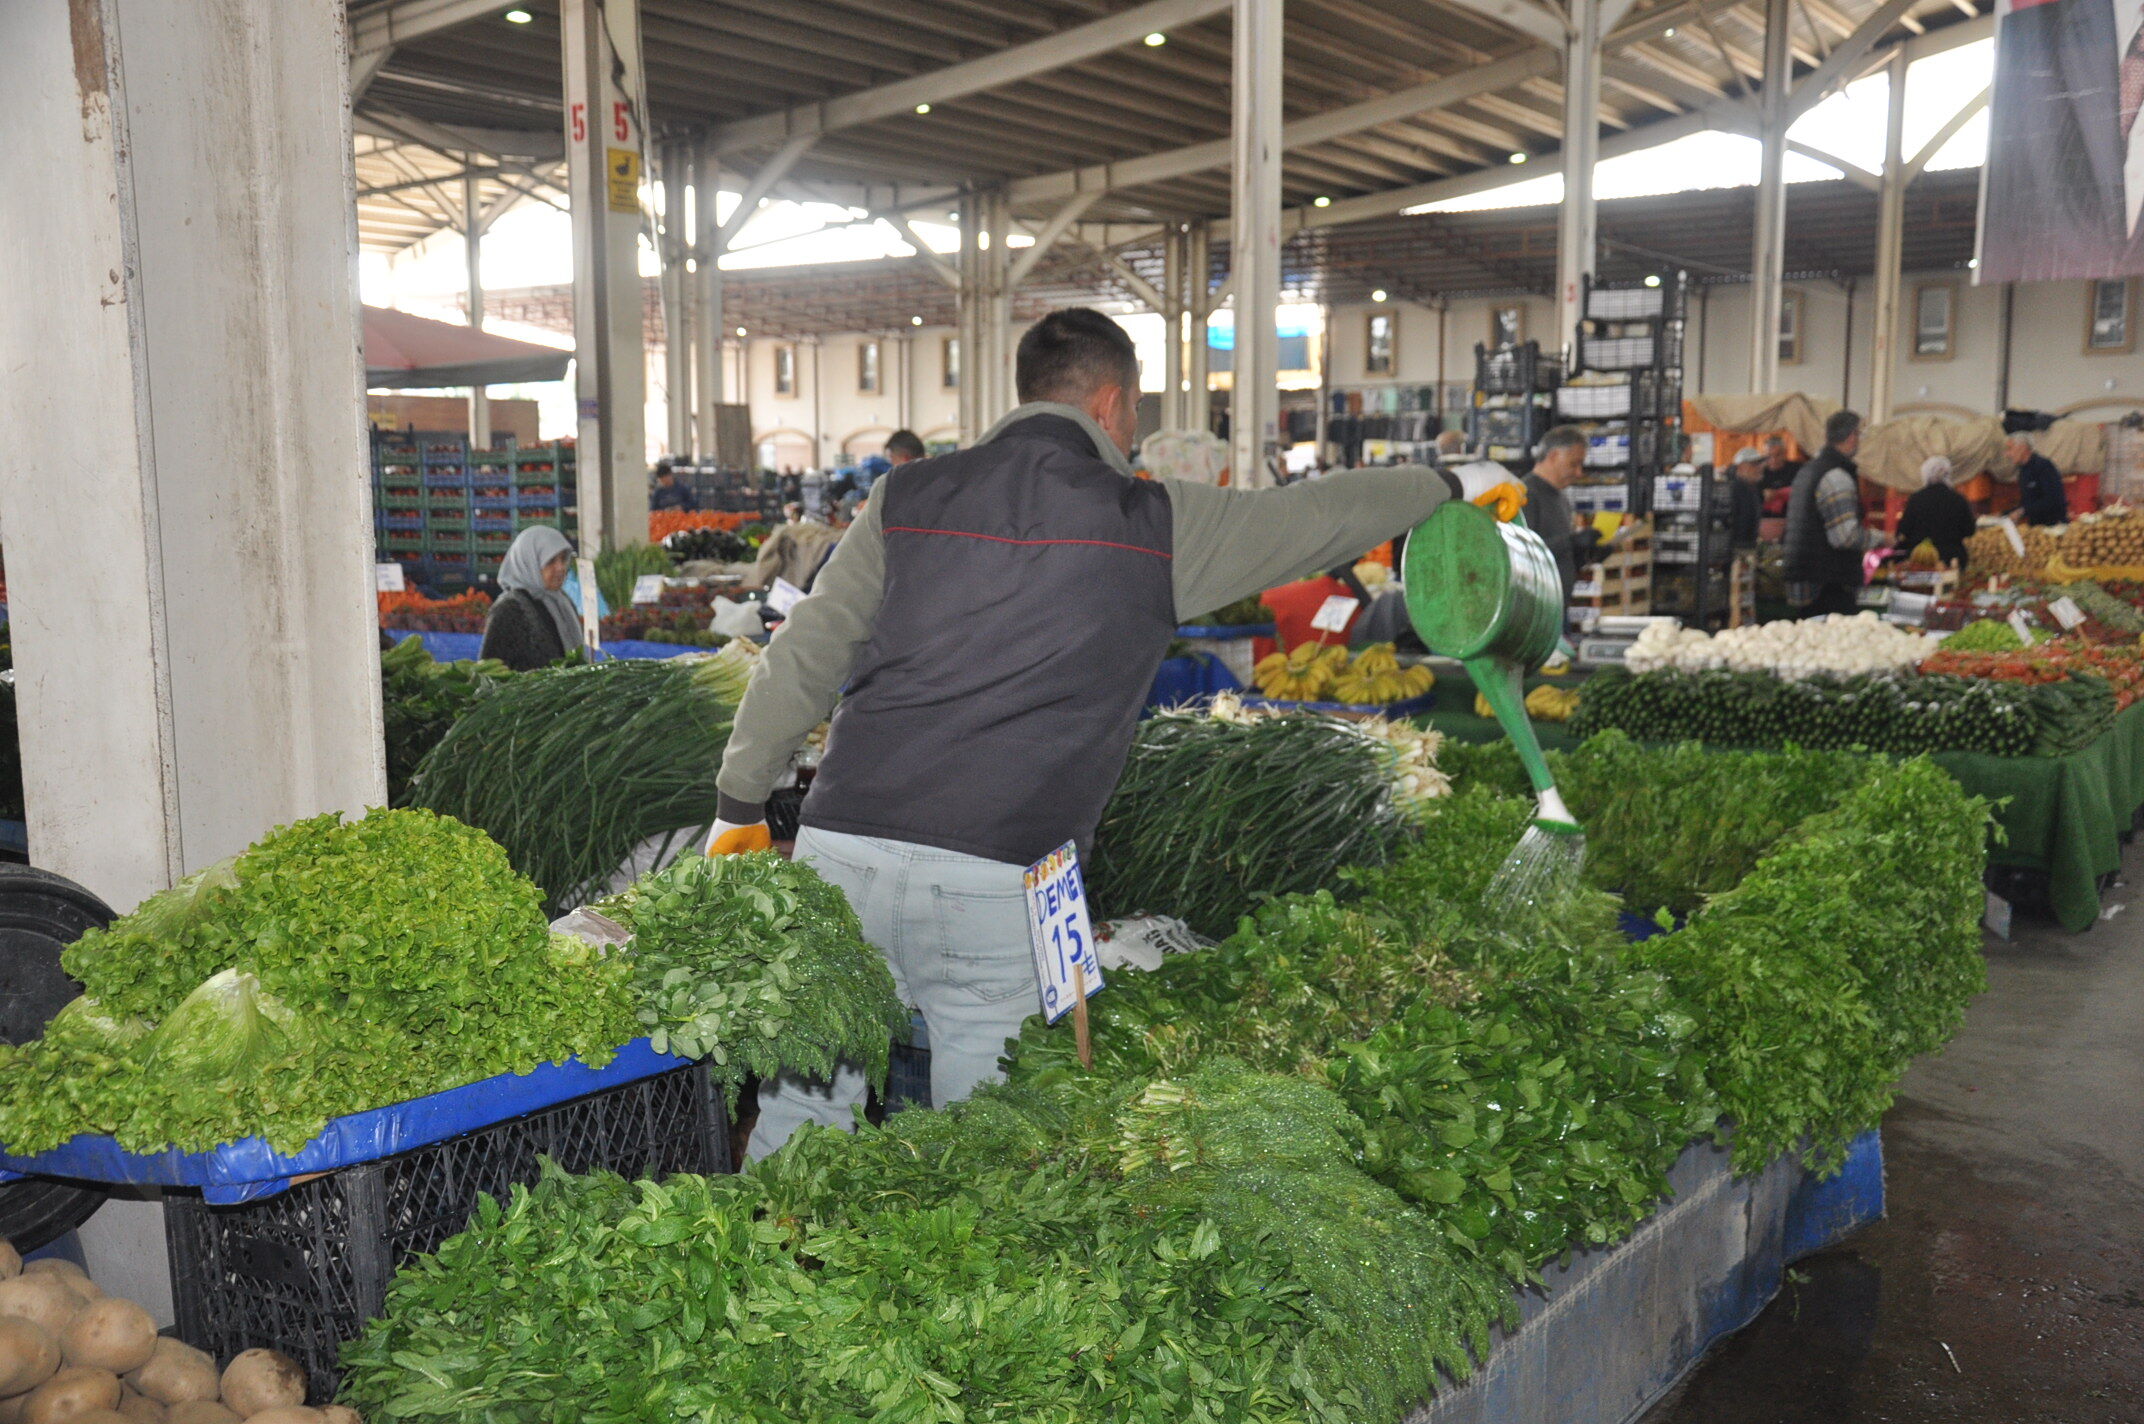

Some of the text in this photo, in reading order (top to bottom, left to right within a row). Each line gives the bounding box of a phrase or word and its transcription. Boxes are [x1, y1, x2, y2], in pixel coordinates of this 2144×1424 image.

[571, 103, 585, 142] 5
[613, 101, 629, 142] 5
[1052, 912, 1083, 984] 15
